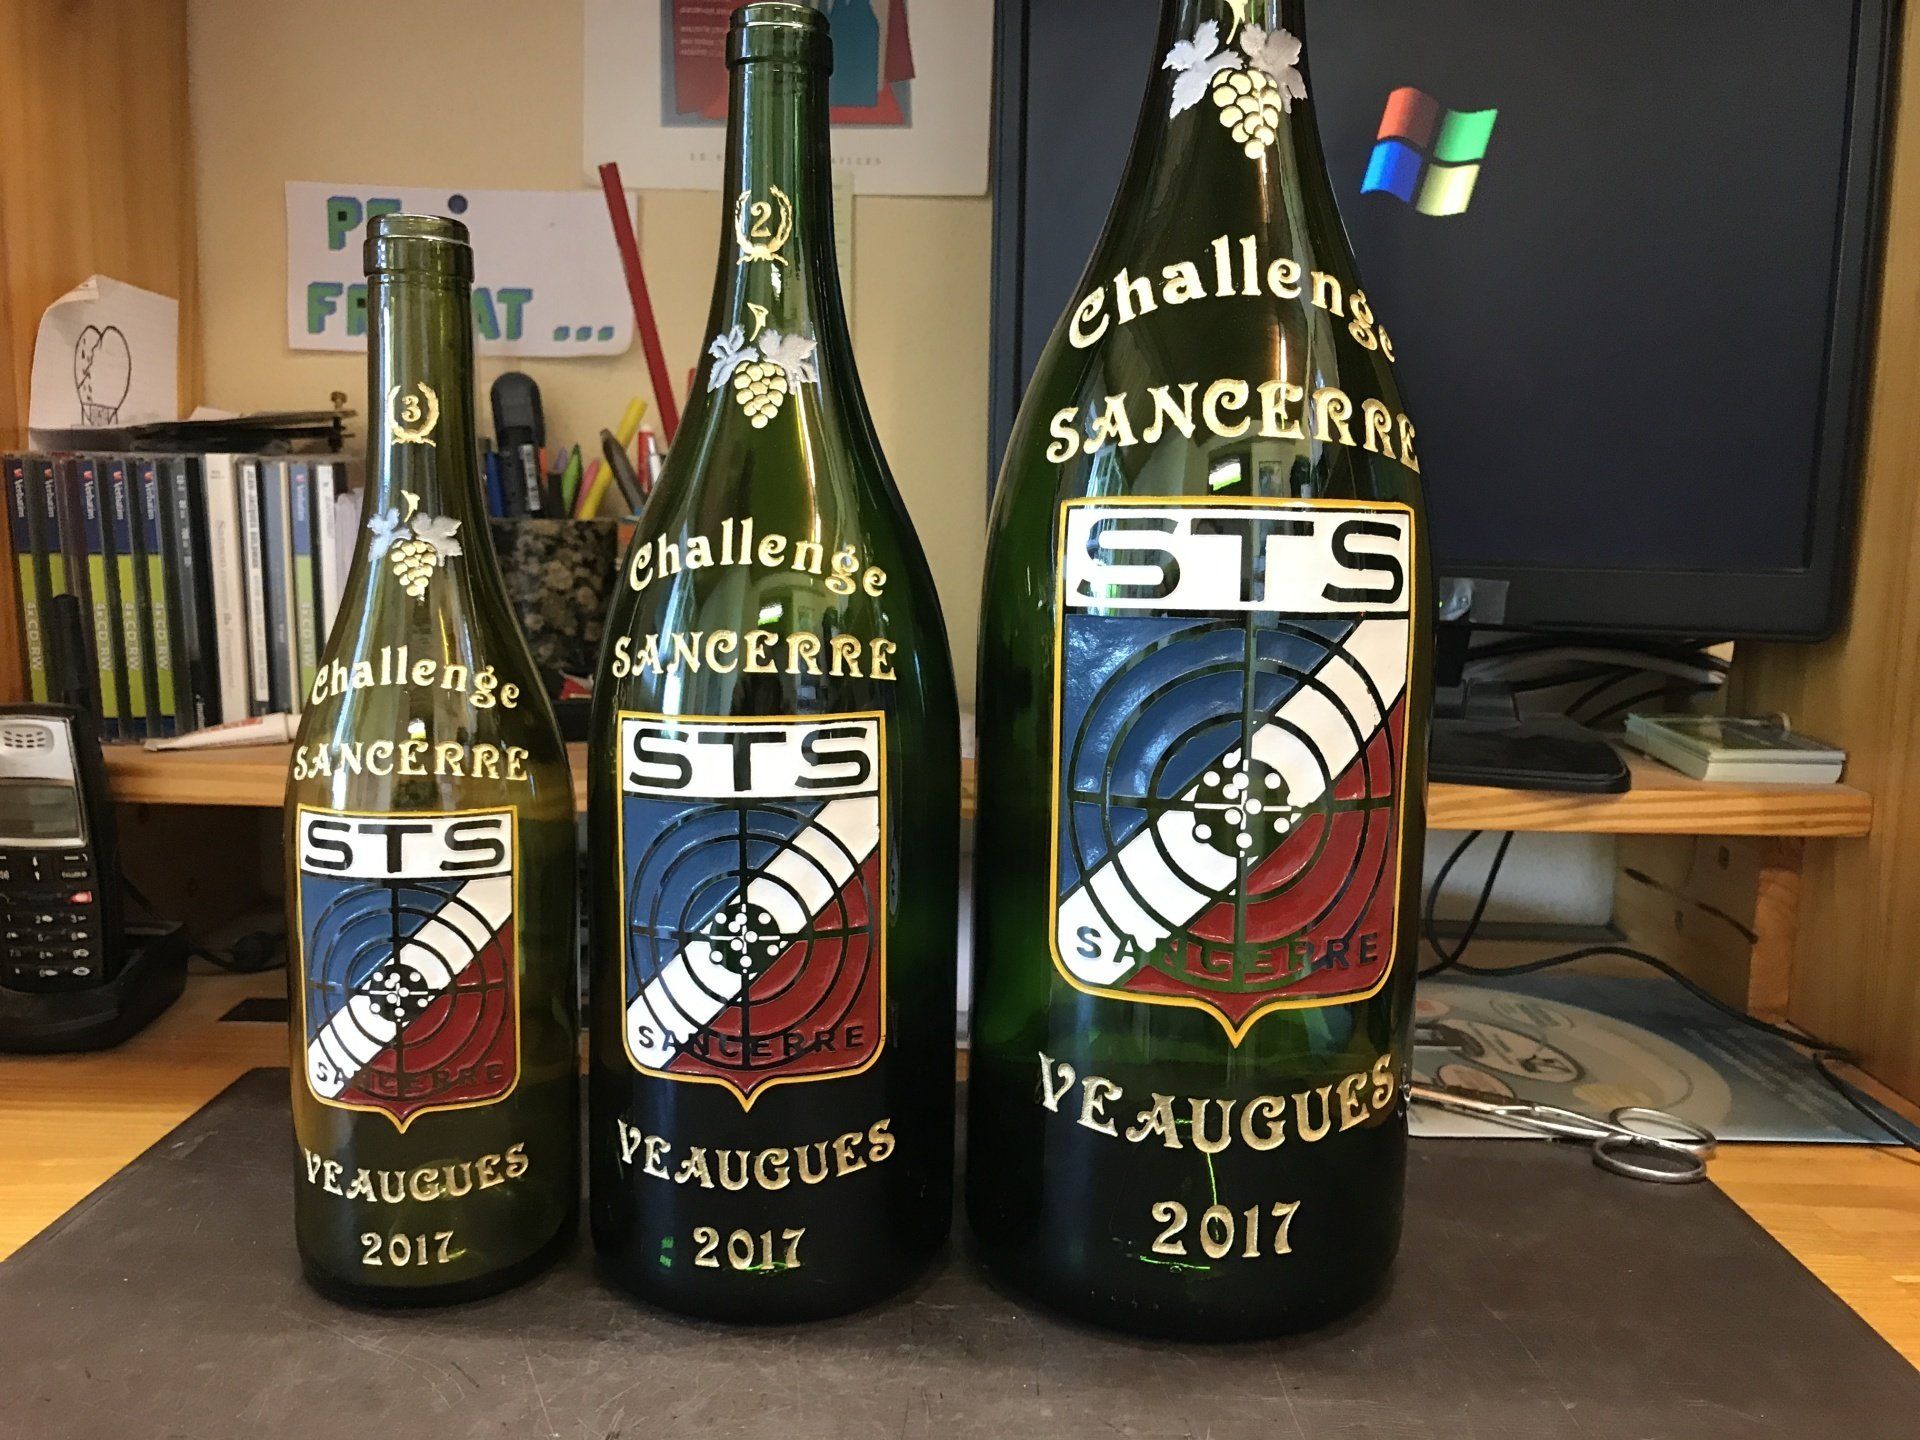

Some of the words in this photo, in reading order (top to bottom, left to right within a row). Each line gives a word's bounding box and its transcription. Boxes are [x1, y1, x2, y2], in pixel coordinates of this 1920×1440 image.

[750, 201, 772, 238] 2
[1068, 234, 1396, 363] Challenge
[401, 394, 422, 423] 3
[1045, 378, 1421, 475] SANCERRE
[629, 516, 887, 597] Challenge
[1076, 516, 1404, 604] STS
[311, 644, 520, 709] Challenge
[612, 629, 898, 681] SANCERRE
[293, 739, 529, 781] SANCERRE
[629, 727, 871, 792] STS
[304, 819, 506, 874] STS
[1076, 925, 1379, 971] SANCERRE
[638, 1025, 865, 1057] SANCERRE
[1038, 1051, 1395, 1154] VEAUGUES
[304, 1141, 529, 1203] VEAUGUES
[617, 1118, 896, 1191] VEAUGUES
[360, 1230, 454, 1267] 2017
[693, 1226, 806, 1270] 2017
[1151, 1200, 1301, 1259] 2017
